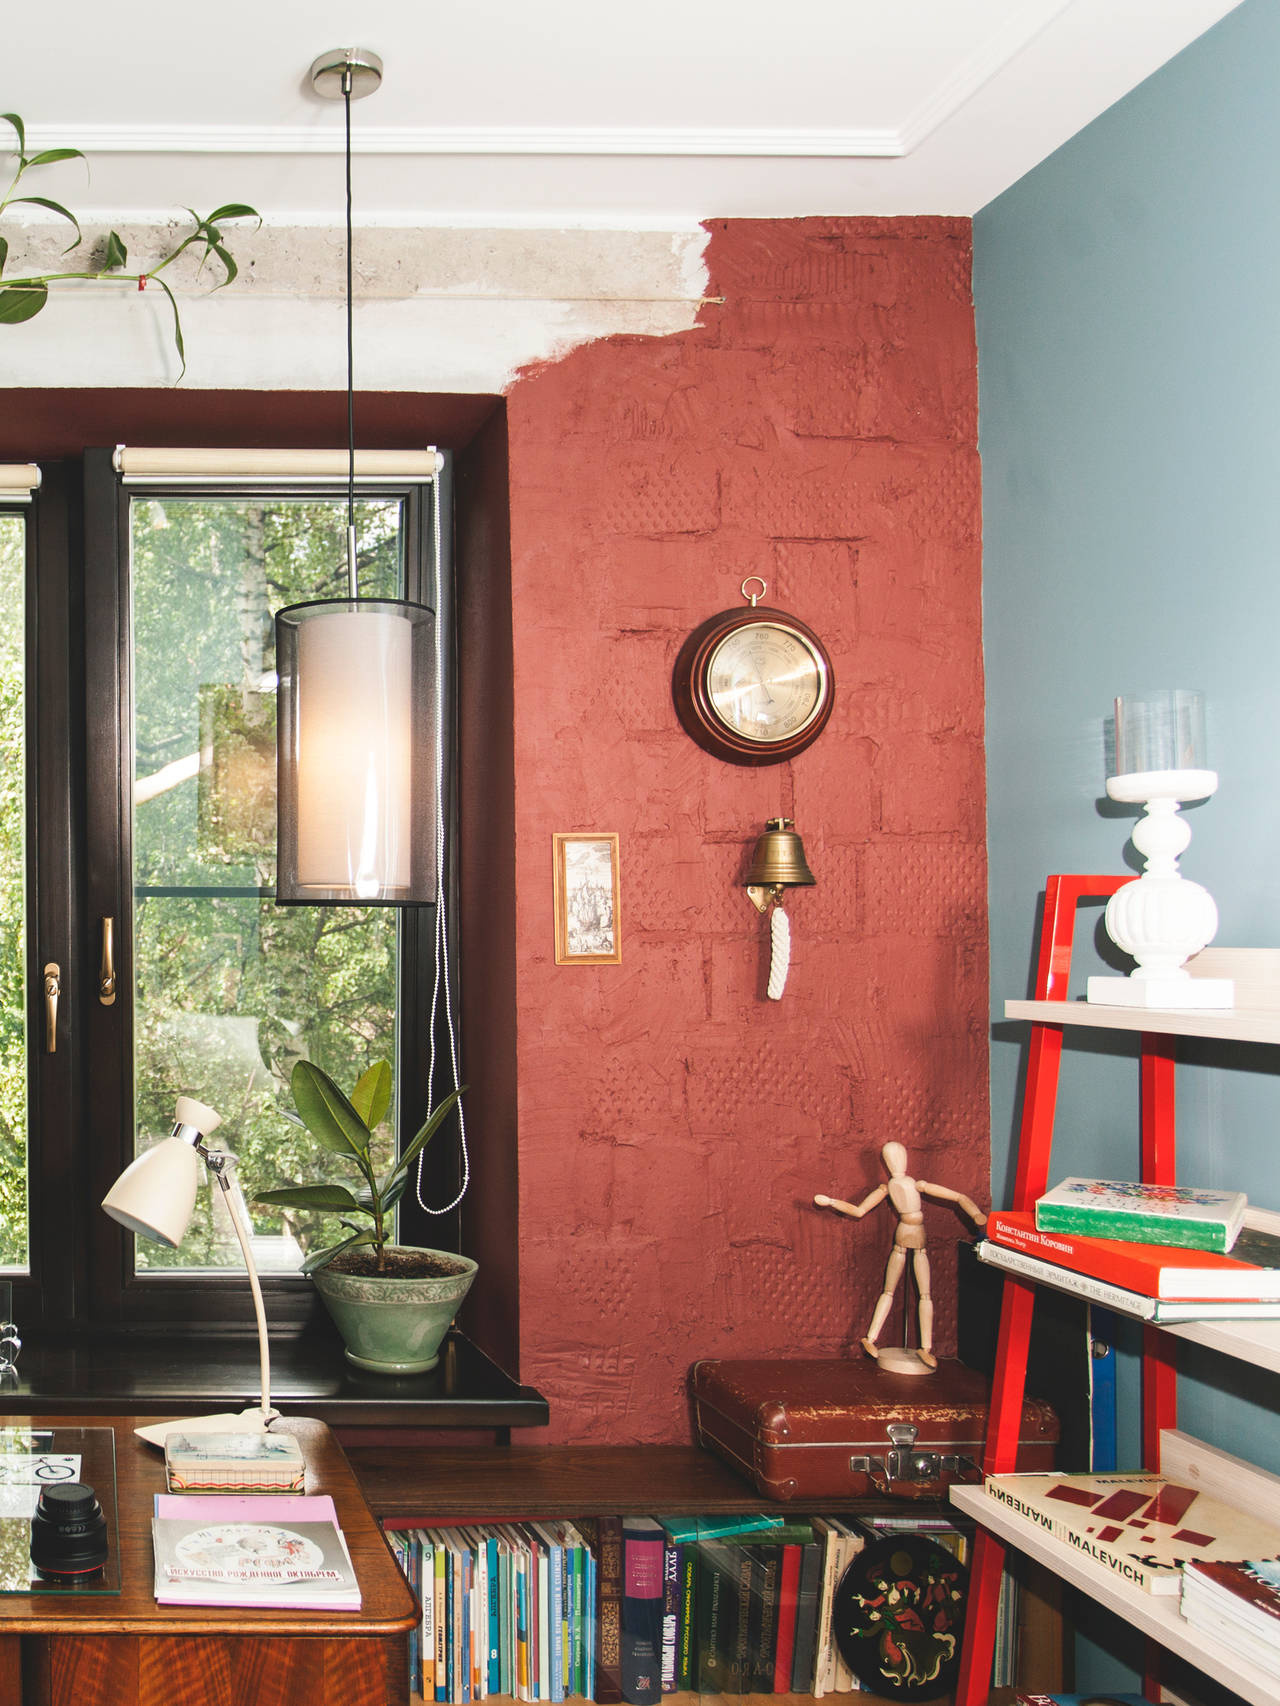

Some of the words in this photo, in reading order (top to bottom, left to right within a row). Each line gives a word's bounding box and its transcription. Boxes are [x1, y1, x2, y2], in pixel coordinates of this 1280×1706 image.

[1089, 1284, 1102, 1298] THE
[989, 1484, 1053, 1531] МАЛЕВИЧ
[425, 1552, 432, 1561] 9
[668, 1551, 678, 1582] ДАЛЬ
[1068, 1531, 1144, 1586] MALEVICH
[662, 1614, 677, 1645] СЛОВАРЬ
[490, 1648, 498, 1660] 8
